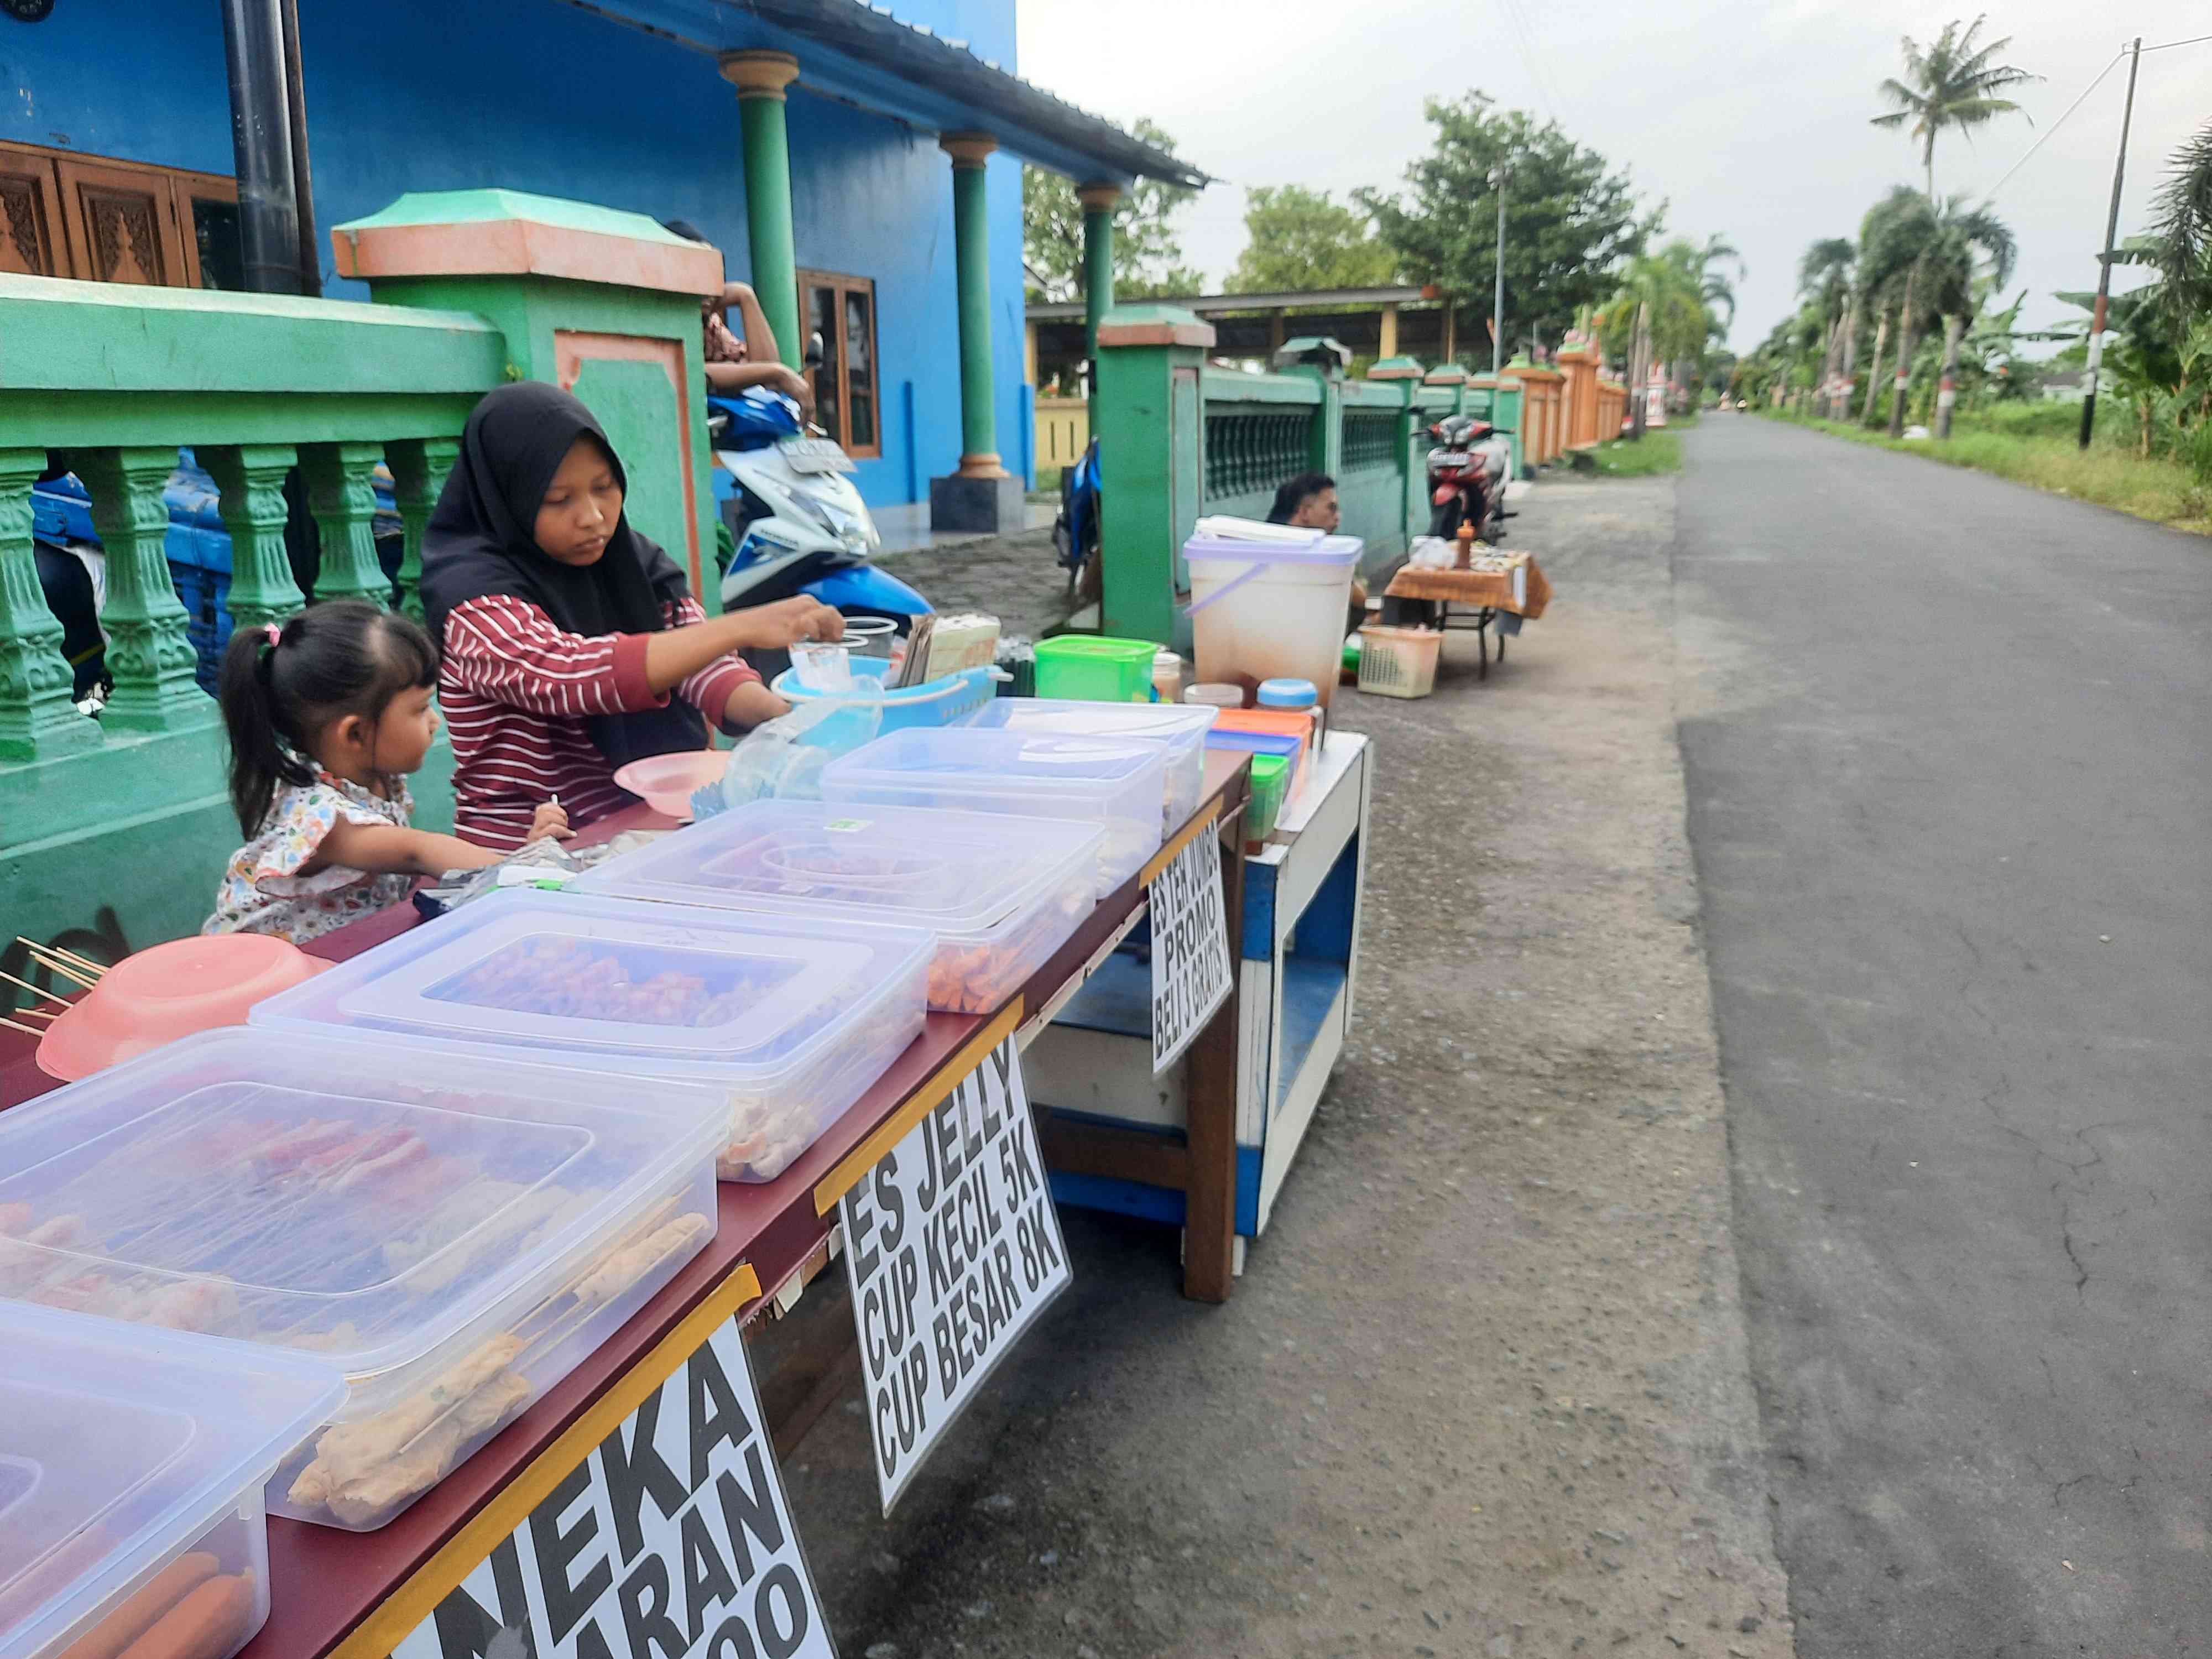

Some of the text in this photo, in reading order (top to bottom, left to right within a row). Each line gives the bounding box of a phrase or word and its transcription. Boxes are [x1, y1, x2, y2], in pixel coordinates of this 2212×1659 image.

[1152, 872, 1167, 937] ES
[1167, 849, 1189, 920] TEH
[1155, 979, 1182, 1060] BELI
[1183, 968, 1190, 1028] 3
[1192, 930, 1223, 1018] GRATIS
[1165, 885, 1216, 982] PROMO
[846, 1035, 1014, 1287] ES JELLY
[863, 1117, 1039, 1382] CUP KECIL 5K
[876, 1195, 1060, 1479] CUP BESAR 8K
[383, 1337, 753, 1659] NEKA
